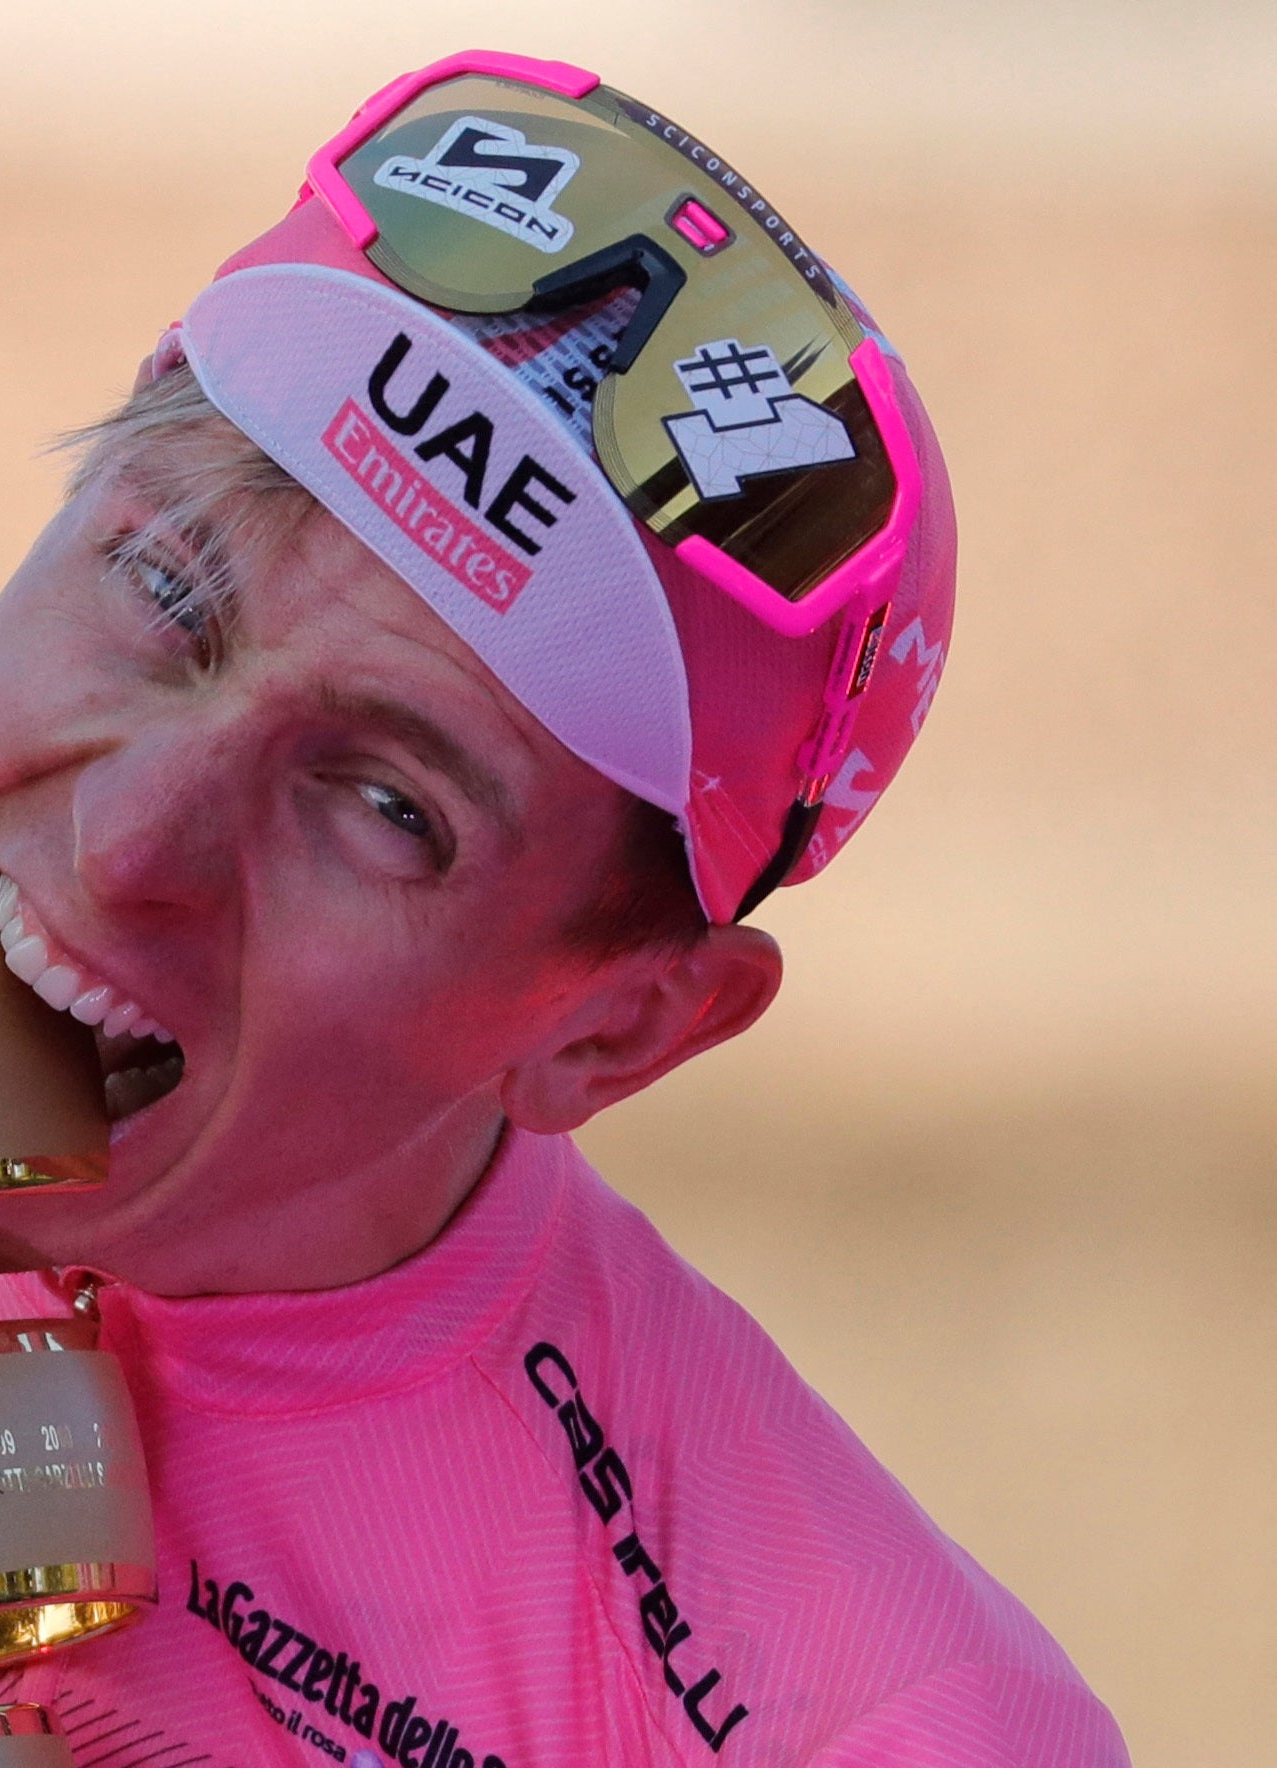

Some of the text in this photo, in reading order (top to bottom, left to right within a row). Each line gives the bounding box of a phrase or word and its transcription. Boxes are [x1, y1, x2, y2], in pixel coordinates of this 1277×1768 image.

[388, 165, 560, 241] SCICON
[646, 103, 821, 281] SCICONSPORTS
[332, 408, 515, 602] Emirates
[368, 331, 578, 557] UAE
[286, 1710, 301, 1737] il
[301, 1724, 346, 1764] rosa
